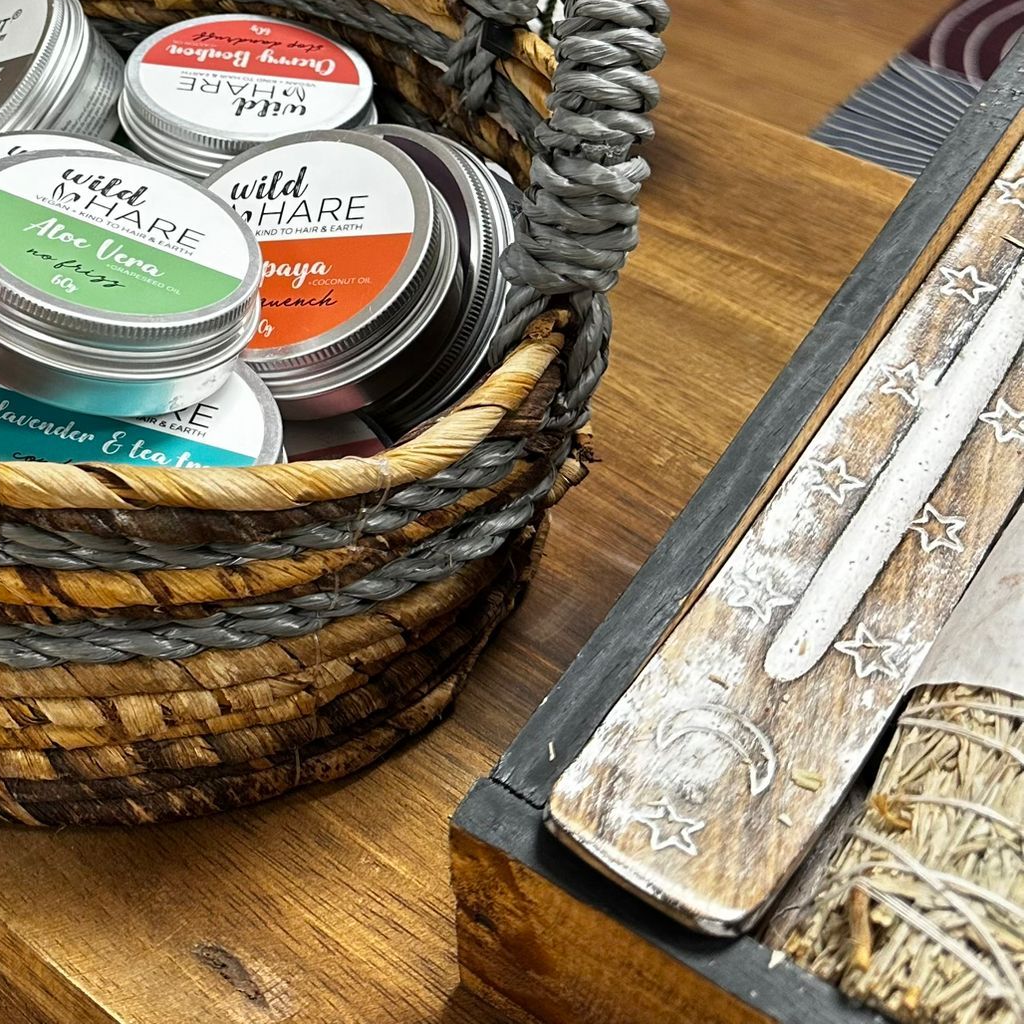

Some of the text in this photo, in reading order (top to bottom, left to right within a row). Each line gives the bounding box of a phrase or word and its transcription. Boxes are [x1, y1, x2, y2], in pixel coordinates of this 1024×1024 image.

[192, 31, 283, 50] dandruff
[250, 24, 272, 36] 60g
[165, 44, 336, 76] Cherry Bonbon
[287, 40, 324, 53] stop
[176, 76, 276, 100] HARE
[232, 97, 307, 118] wild
[62, 168, 149, 207] wild
[230, 166, 309, 201] wild
[84, 194, 206, 249] HARE
[258, 195, 369, 226] HARE
[35, 194, 70, 212] VEGAN
[79, 210, 104, 225] KIND
[104, 218, 120, 230] TO
[122, 225, 148, 239] HAIR
[157, 239, 195, 257] EARTH
[255, 223, 363, 237] KIND TO HAIR & EARTH
[22, 217, 165, 278] Aloe Vera
[26, 247, 126, 289] no frizz
[357, 277, 372, 286] OIL
[50, 273, 79, 294] 60g
[159, 420, 168, 428] &
[170, 423, 207, 439] EARTH
[102, 429, 126, 456] &
[128, 440, 172, 465] tea
